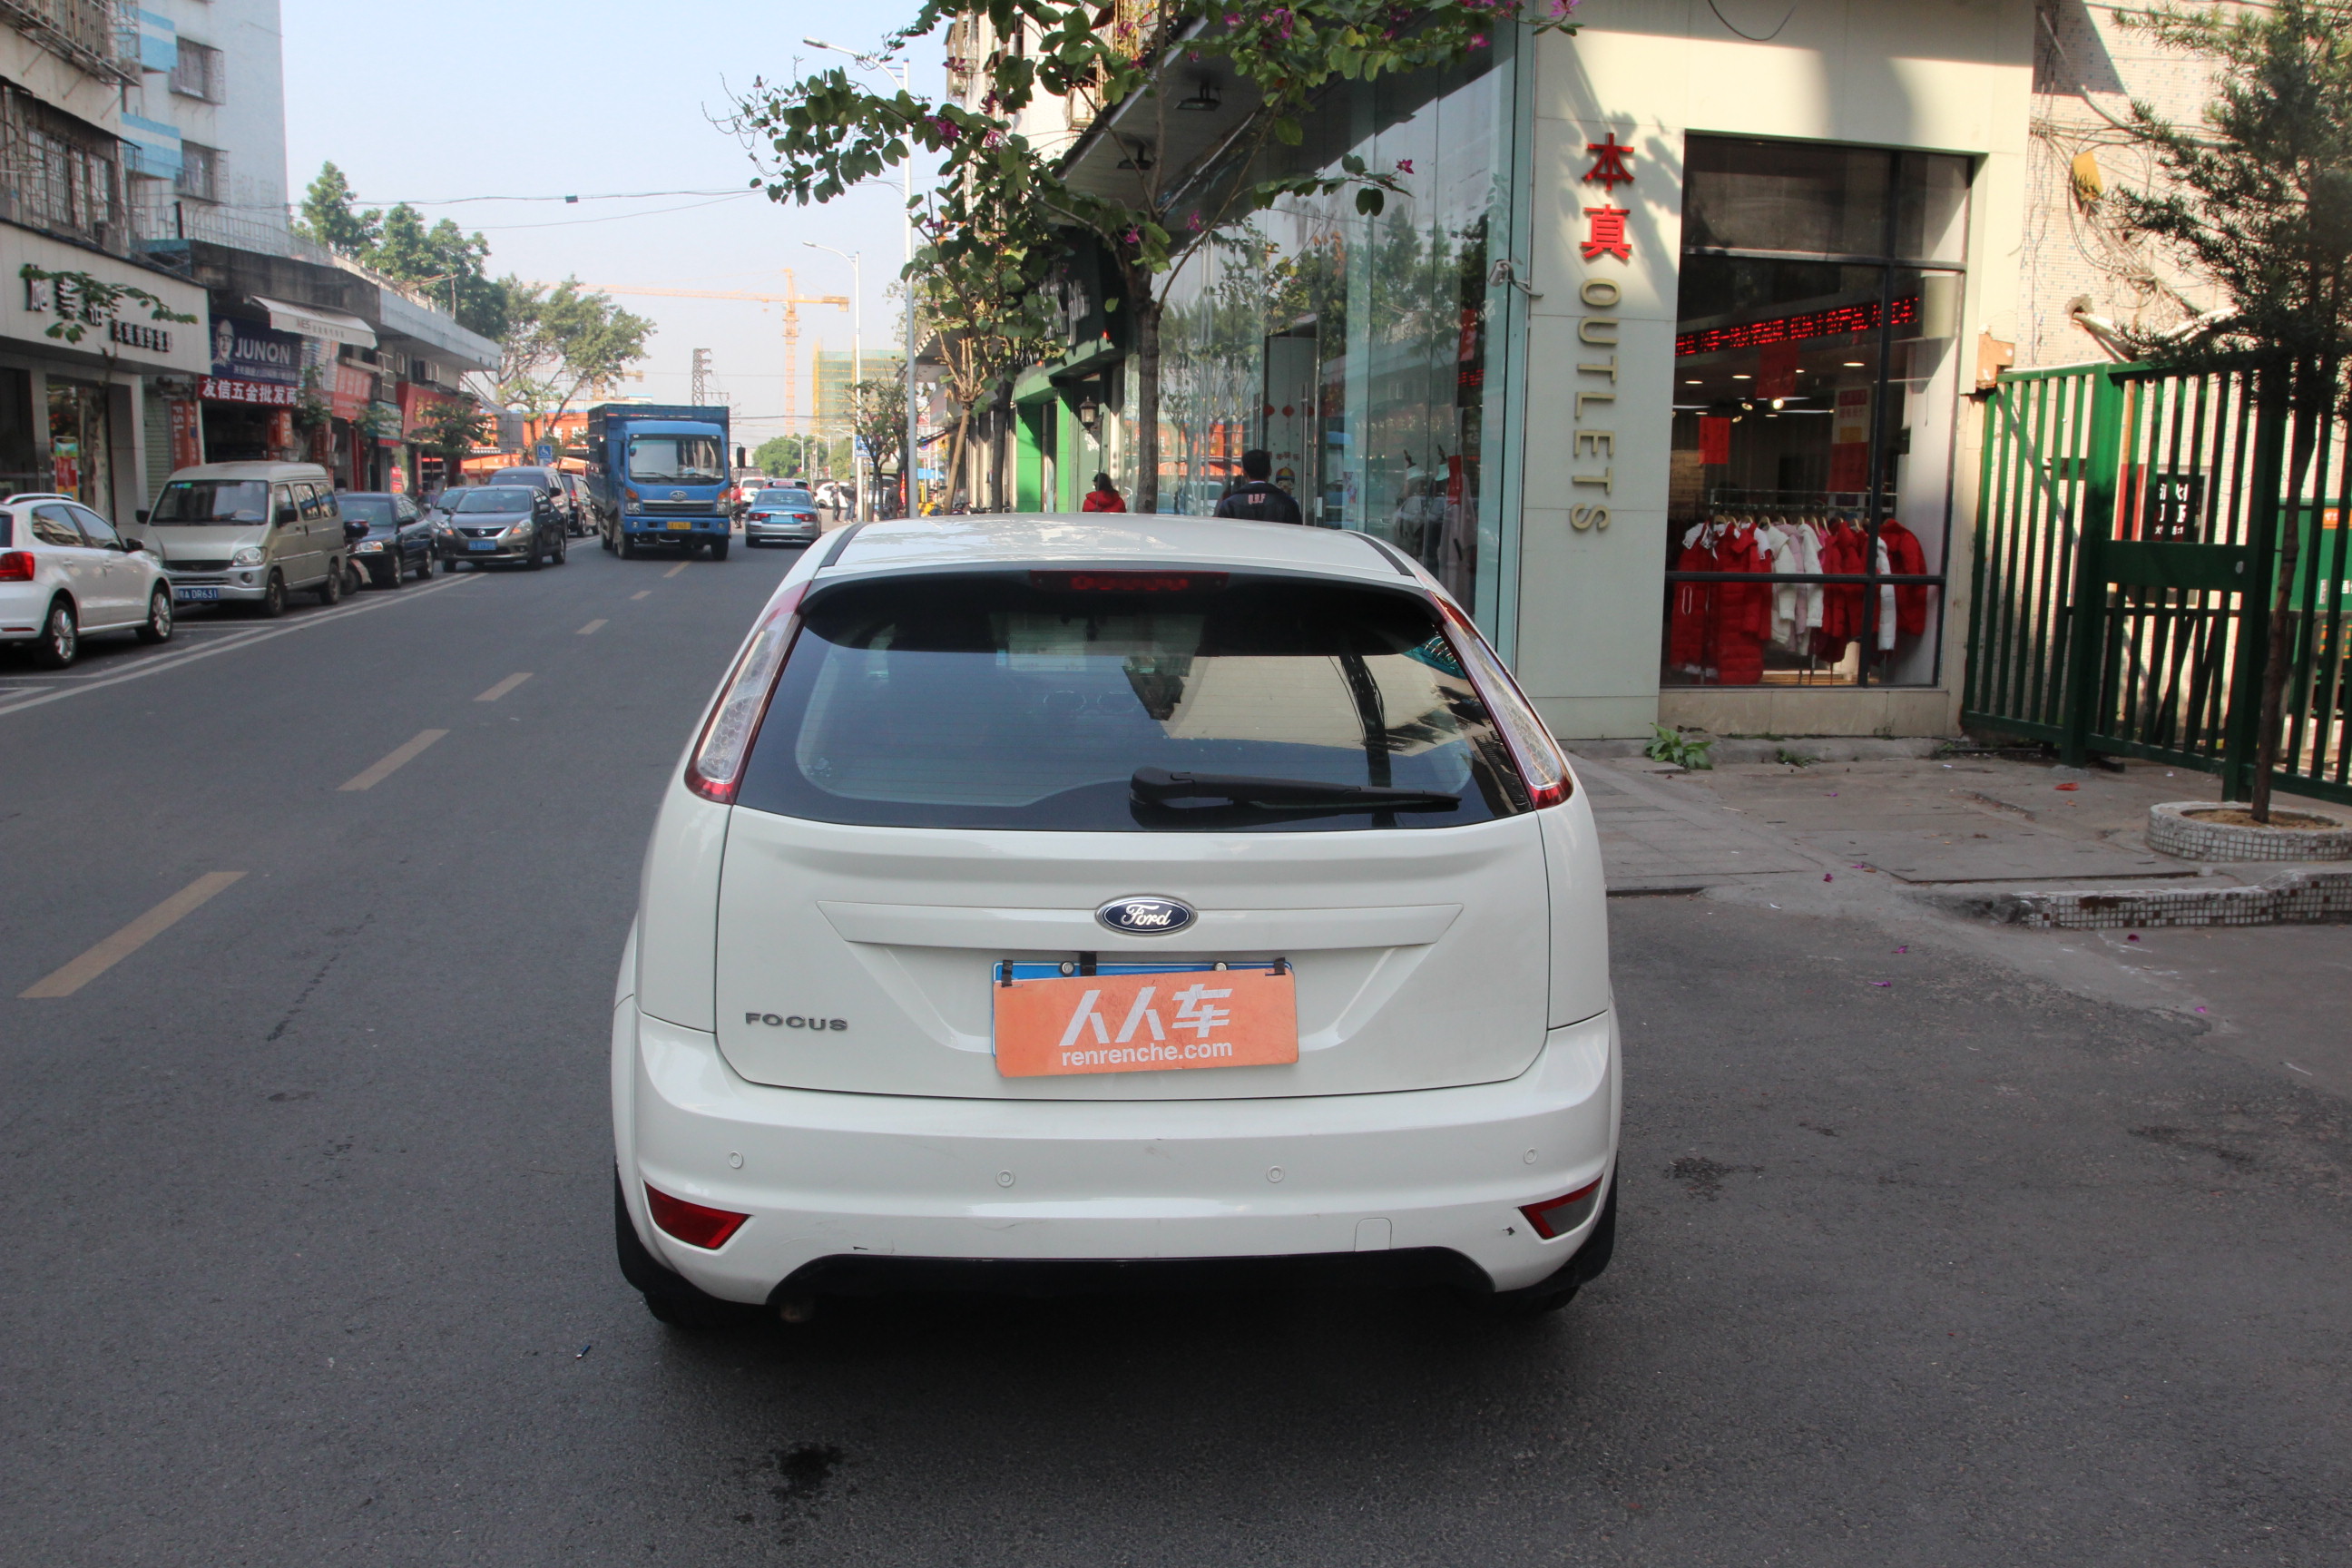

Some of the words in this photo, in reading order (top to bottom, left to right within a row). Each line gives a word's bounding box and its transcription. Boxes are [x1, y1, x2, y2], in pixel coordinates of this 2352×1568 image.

[1581, 132, 1634, 261] 本真
[235, 338, 290, 364] JUNON
[202, 378, 307, 408] 友信五金批发商
[1569, 278, 1621, 532] OUTLETS
[1121, 902, 1171, 927] Ford
[745, 1012, 848, 1032] FOCUS
[1059, 984, 1233, 1047] 人人车
[1062, 1041, 1233, 1067] renrenche.com
